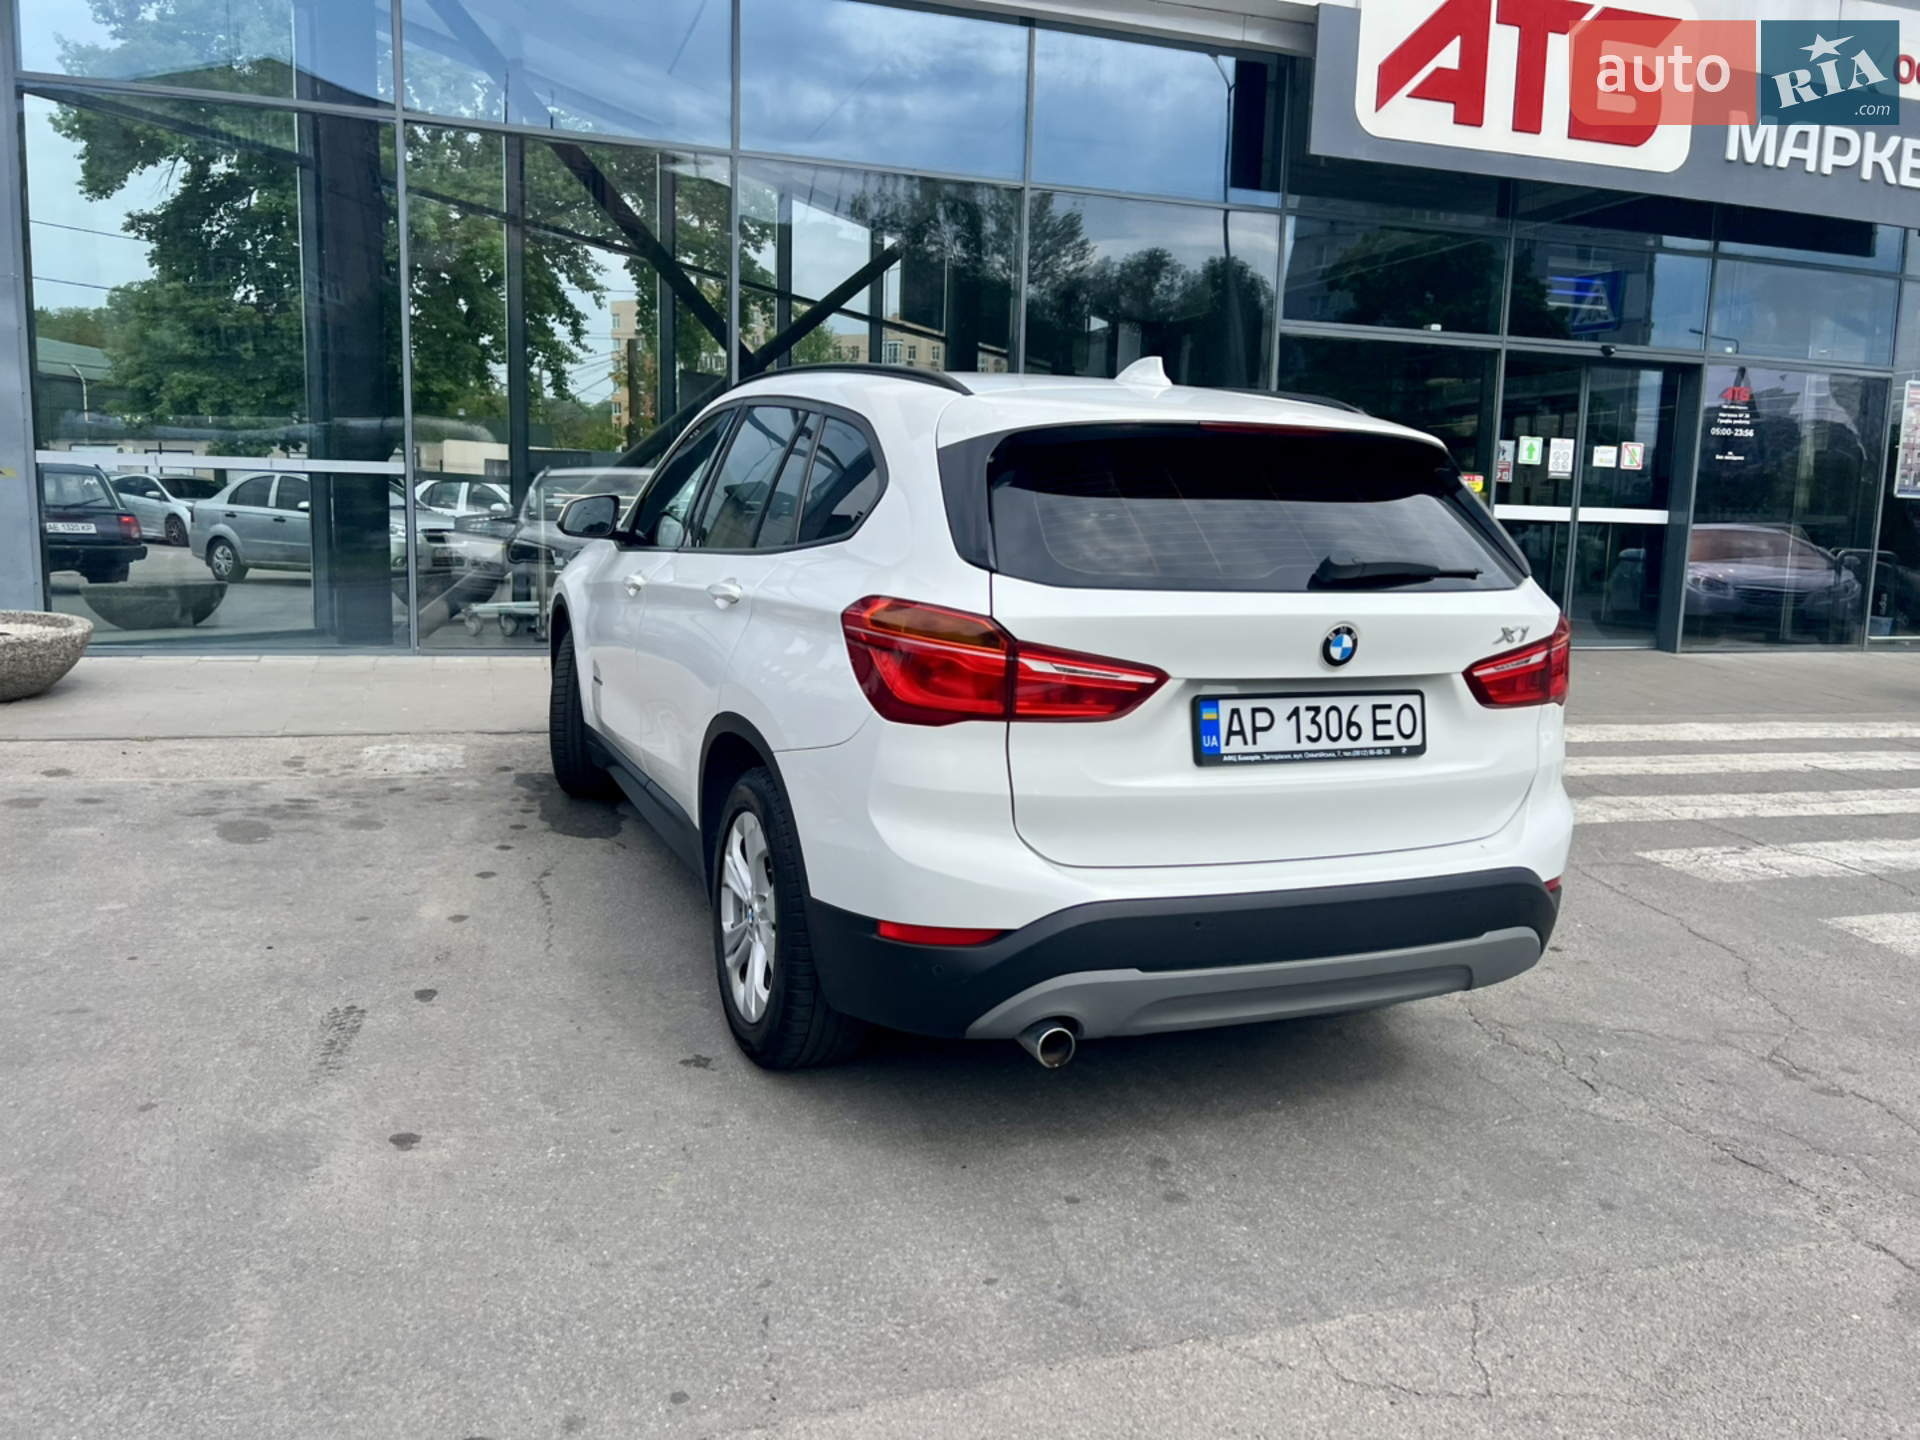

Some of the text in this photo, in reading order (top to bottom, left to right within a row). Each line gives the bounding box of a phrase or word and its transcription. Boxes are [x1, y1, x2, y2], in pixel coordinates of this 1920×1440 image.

[1375, 0, 1683, 148] АТБ
[1492, 626, 1531, 645] X1
[1225, 703, 1417, 747] AP 1306 EO
[1203, 735, 1219, 748] UA
